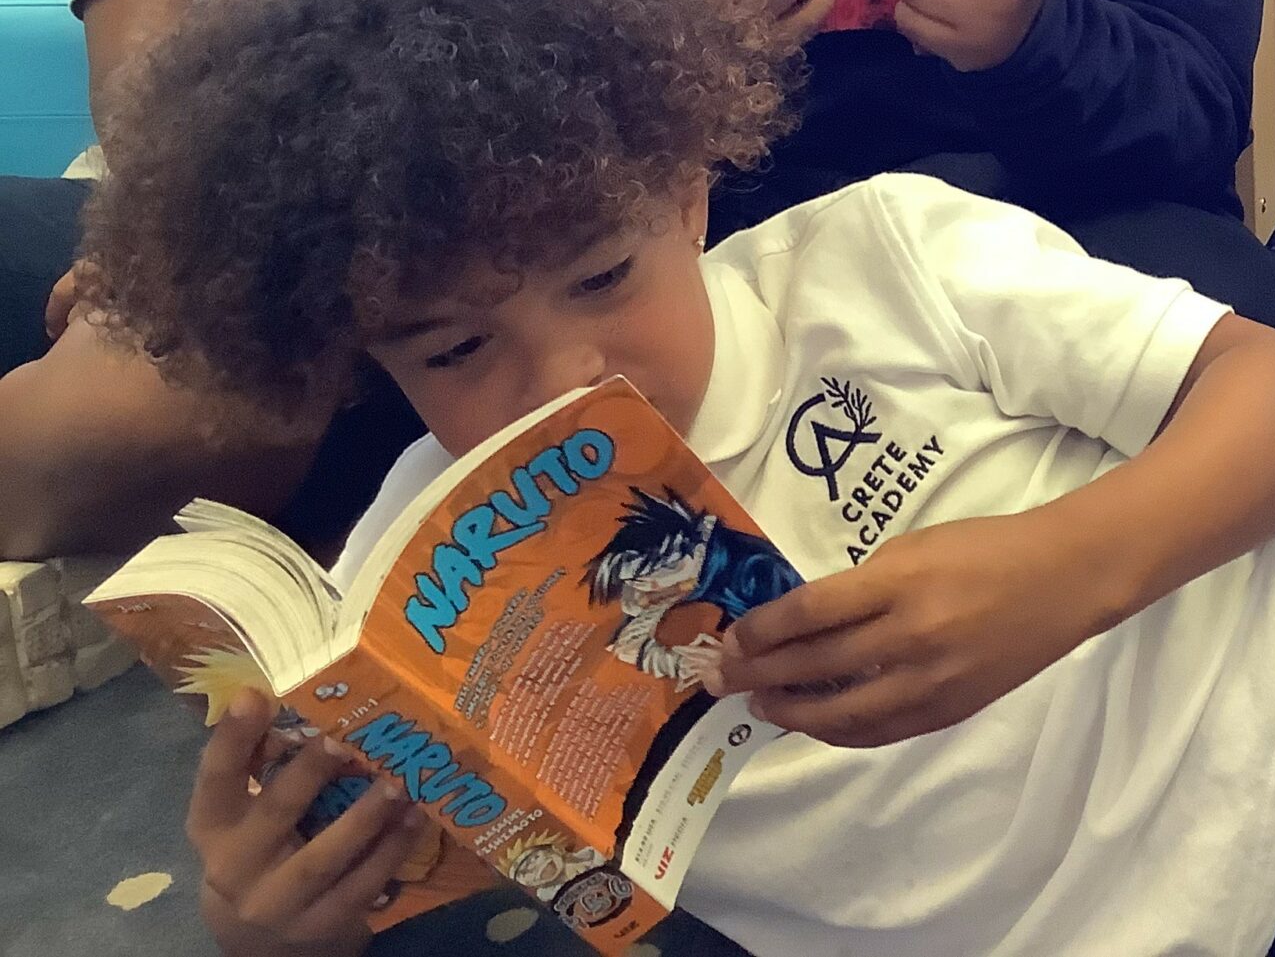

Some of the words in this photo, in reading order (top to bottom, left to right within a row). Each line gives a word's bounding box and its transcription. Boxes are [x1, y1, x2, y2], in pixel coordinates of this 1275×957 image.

[402, 428, 616, 655] NARUTO
[841, 440, 908, 523] CRETE
[846, 434, 945, 566] ACADEMY
[342, 711, 509, 828] NARUTO
